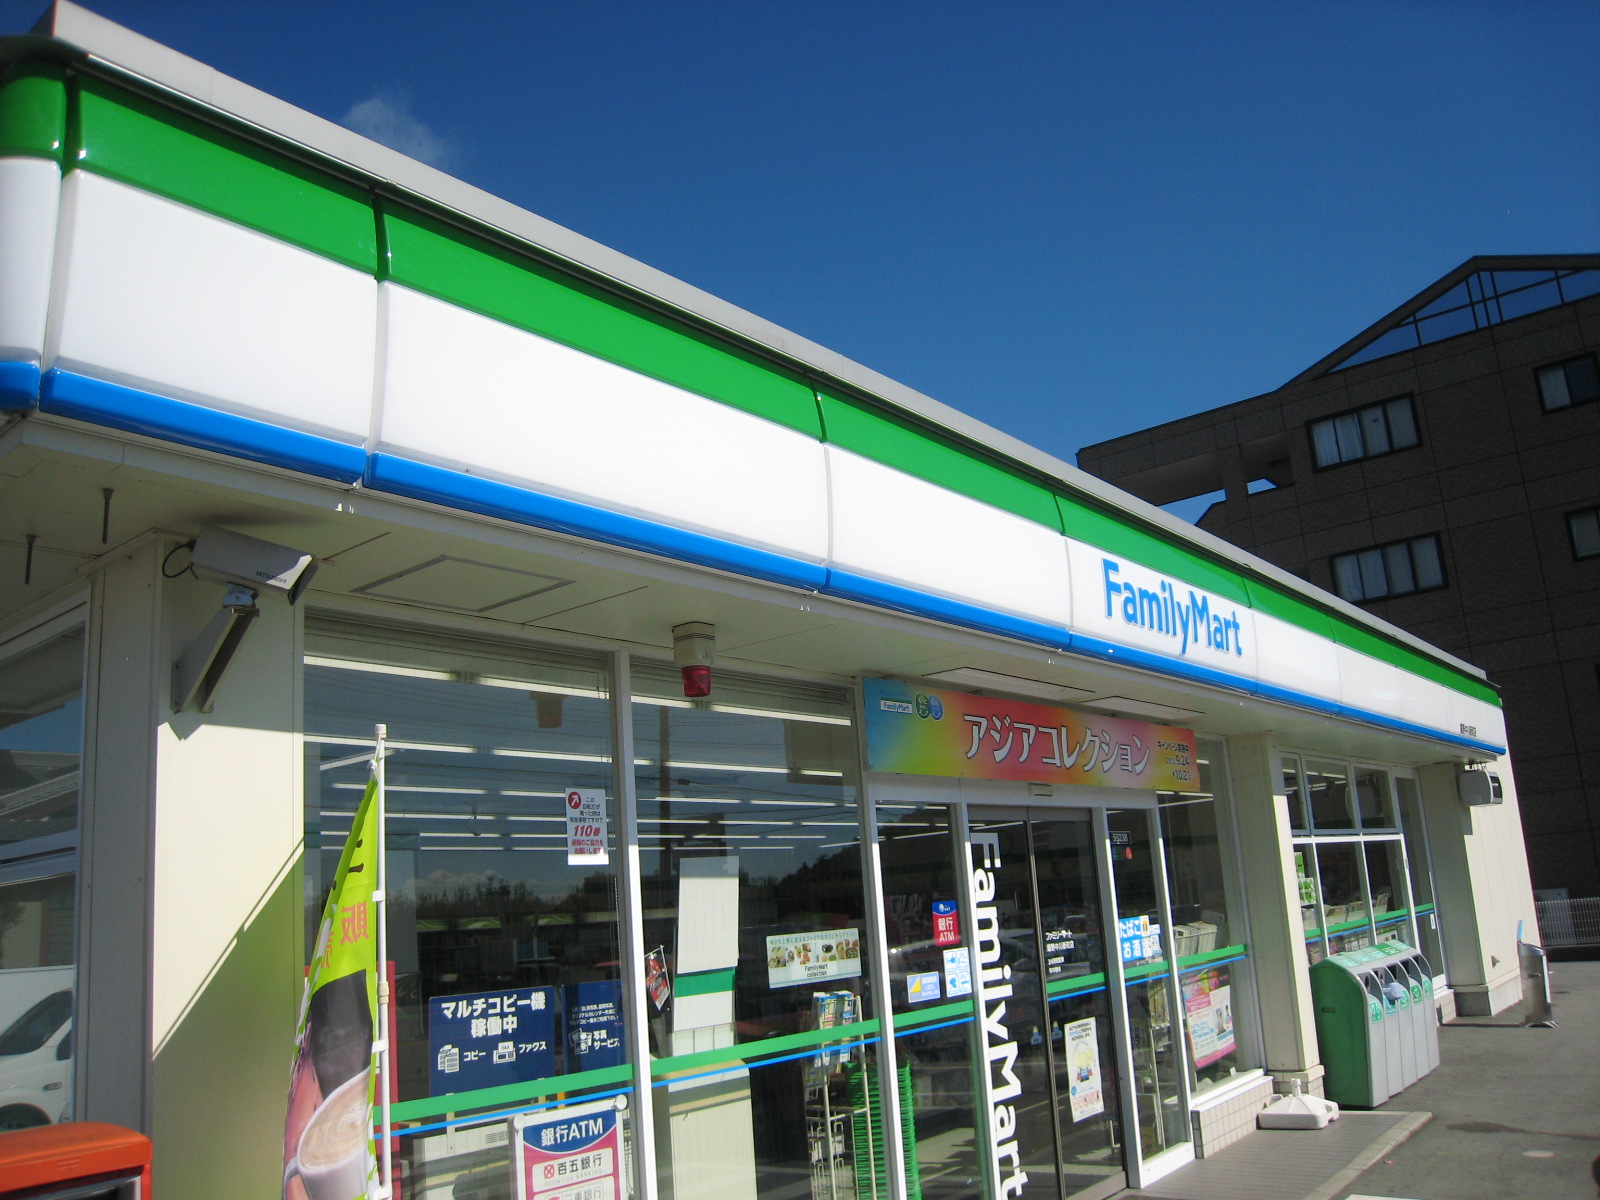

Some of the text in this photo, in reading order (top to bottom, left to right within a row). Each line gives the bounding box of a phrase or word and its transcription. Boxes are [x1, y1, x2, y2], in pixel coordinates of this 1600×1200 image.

[1102, 557, 1243, 656] FamilyMart
[883, 702, 910, 712] FamilyMart
[962, 713, 1150, 775] アジアコレクション
[938, 917, 953, 931] 銀行
[1119, 919, 1141, 938] たばこ
[940, 932, 955, 942] ATM
[1123, 939, 1141, 958] お酒
[804, 964, 828, 972] FamilyMart
[807, 970, 827, 978] collection
[441, 991, 546, 1019] マルチコピー機
[971, 832, 1029, 1200] FamilyMart
[470, 1015, 518, 1039] 稼働中
[593, 1029, 608, 1040] 写真
[518, 1041, 547, 1054] ファクス
[594, 1038, 621, 1051] サービス
[463, 1050, 487, 1062] コピー
[541, 1117, 604, 1147] 銀行ATM
[557, 1153, 603, 1176] 百五銀行
